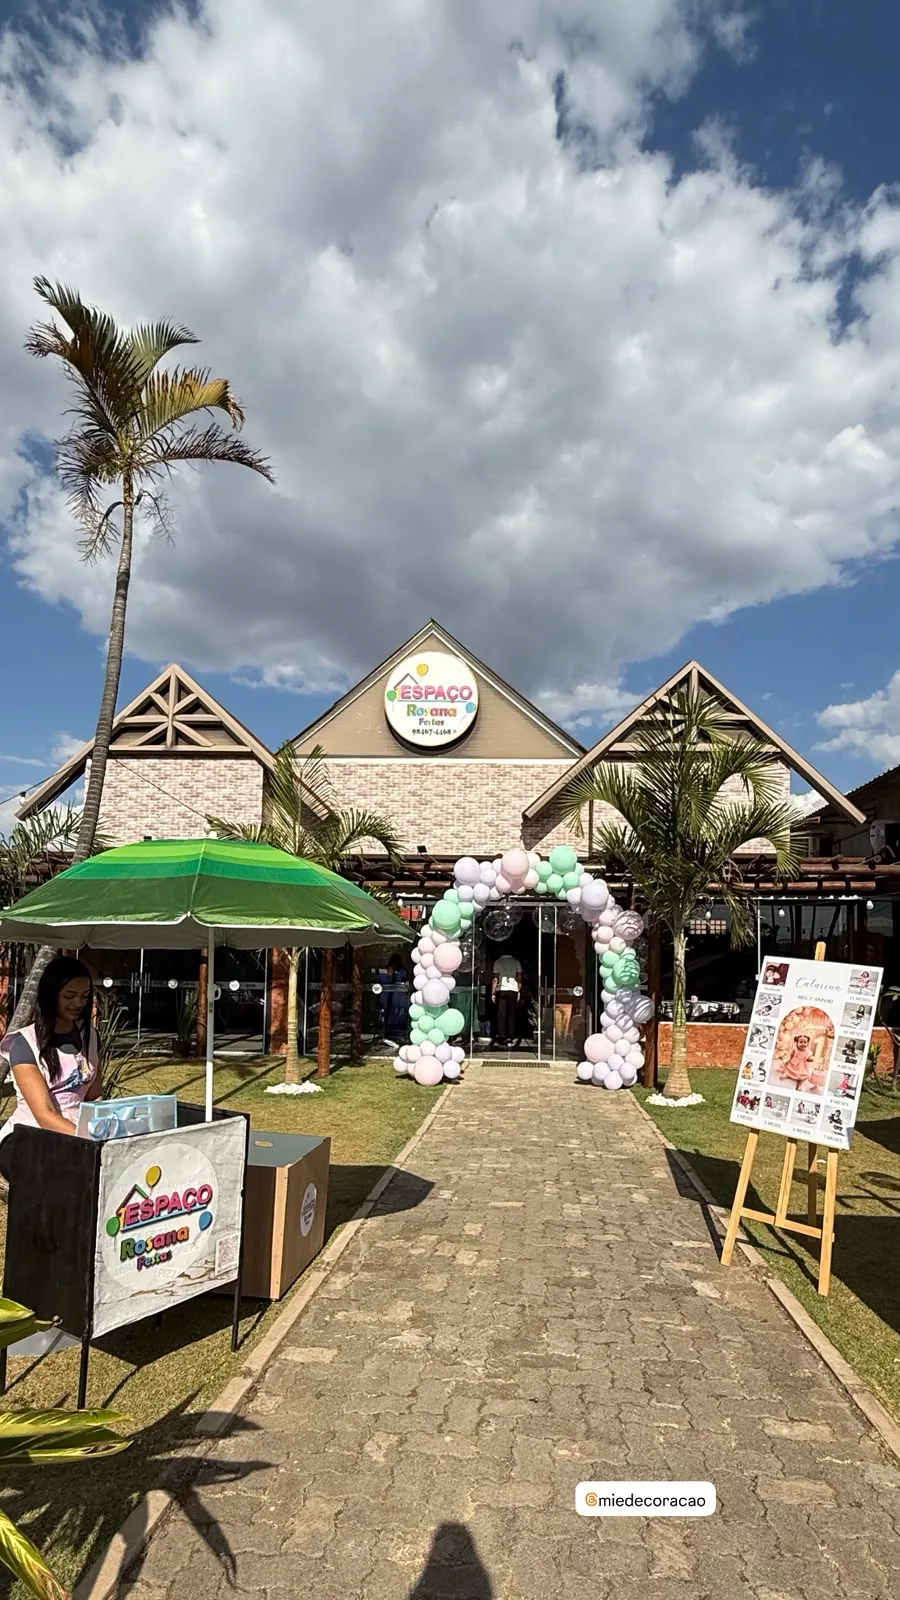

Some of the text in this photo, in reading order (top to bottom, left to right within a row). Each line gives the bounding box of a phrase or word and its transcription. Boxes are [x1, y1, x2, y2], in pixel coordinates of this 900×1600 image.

[400, 685, 473, 703] ESPAÇO
[407, 704, 457, 717] Rosana
[125, 1184, 213, 1226] ESPAÇO
[119, 1226, 190, 1262] Rosana
[136, 1250, 173, 1272] Festas
